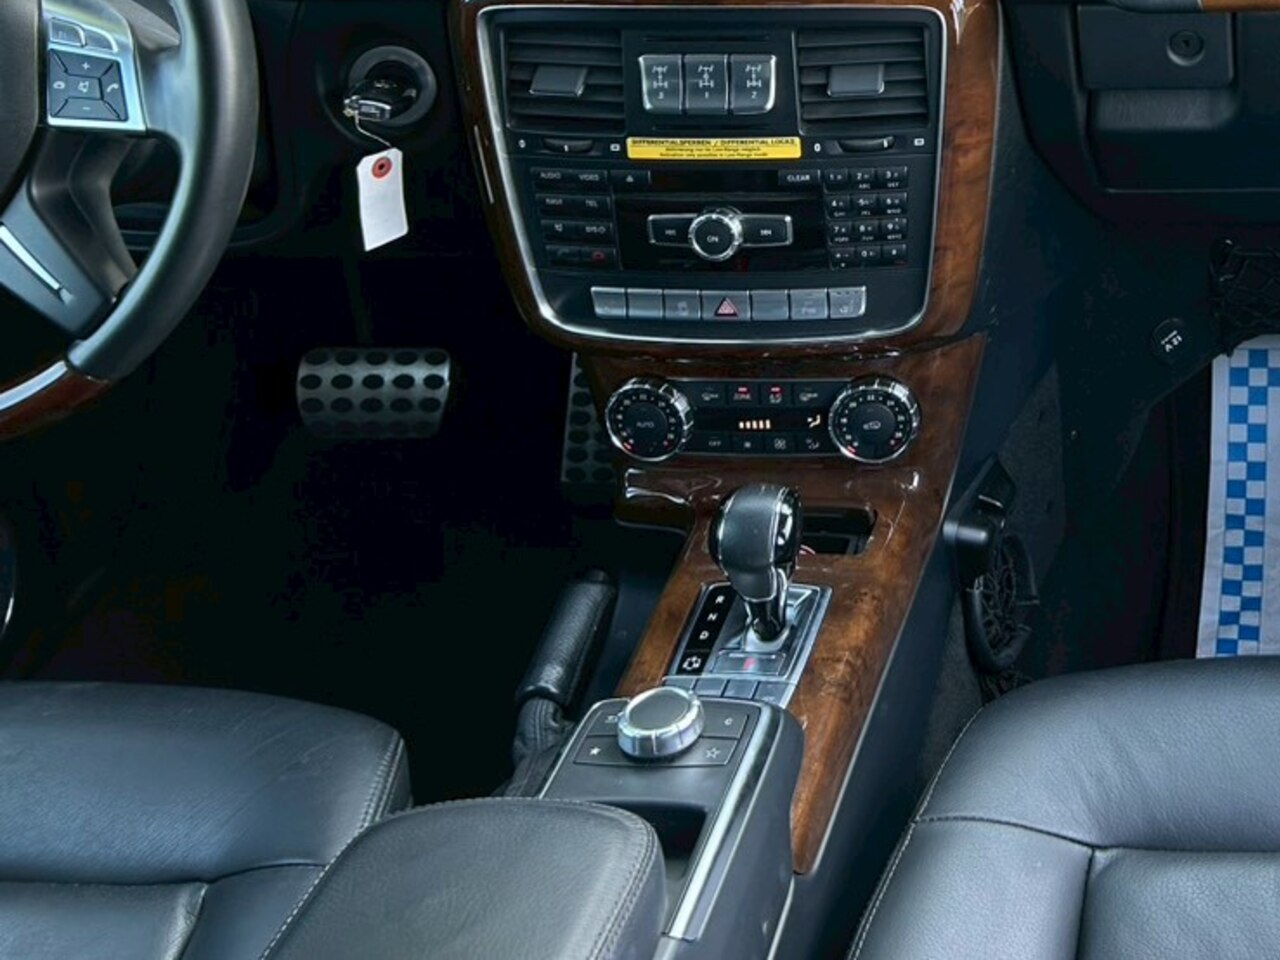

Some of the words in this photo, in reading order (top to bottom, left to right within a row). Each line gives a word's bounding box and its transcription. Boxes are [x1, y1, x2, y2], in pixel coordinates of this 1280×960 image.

[786, 174, 811, 183] CLEAR
[706, 234, 719, 243] ON
[715, 595, 725, 604] R
[707, 613, 718, 621] N
[699, 631, 709, 640] D
